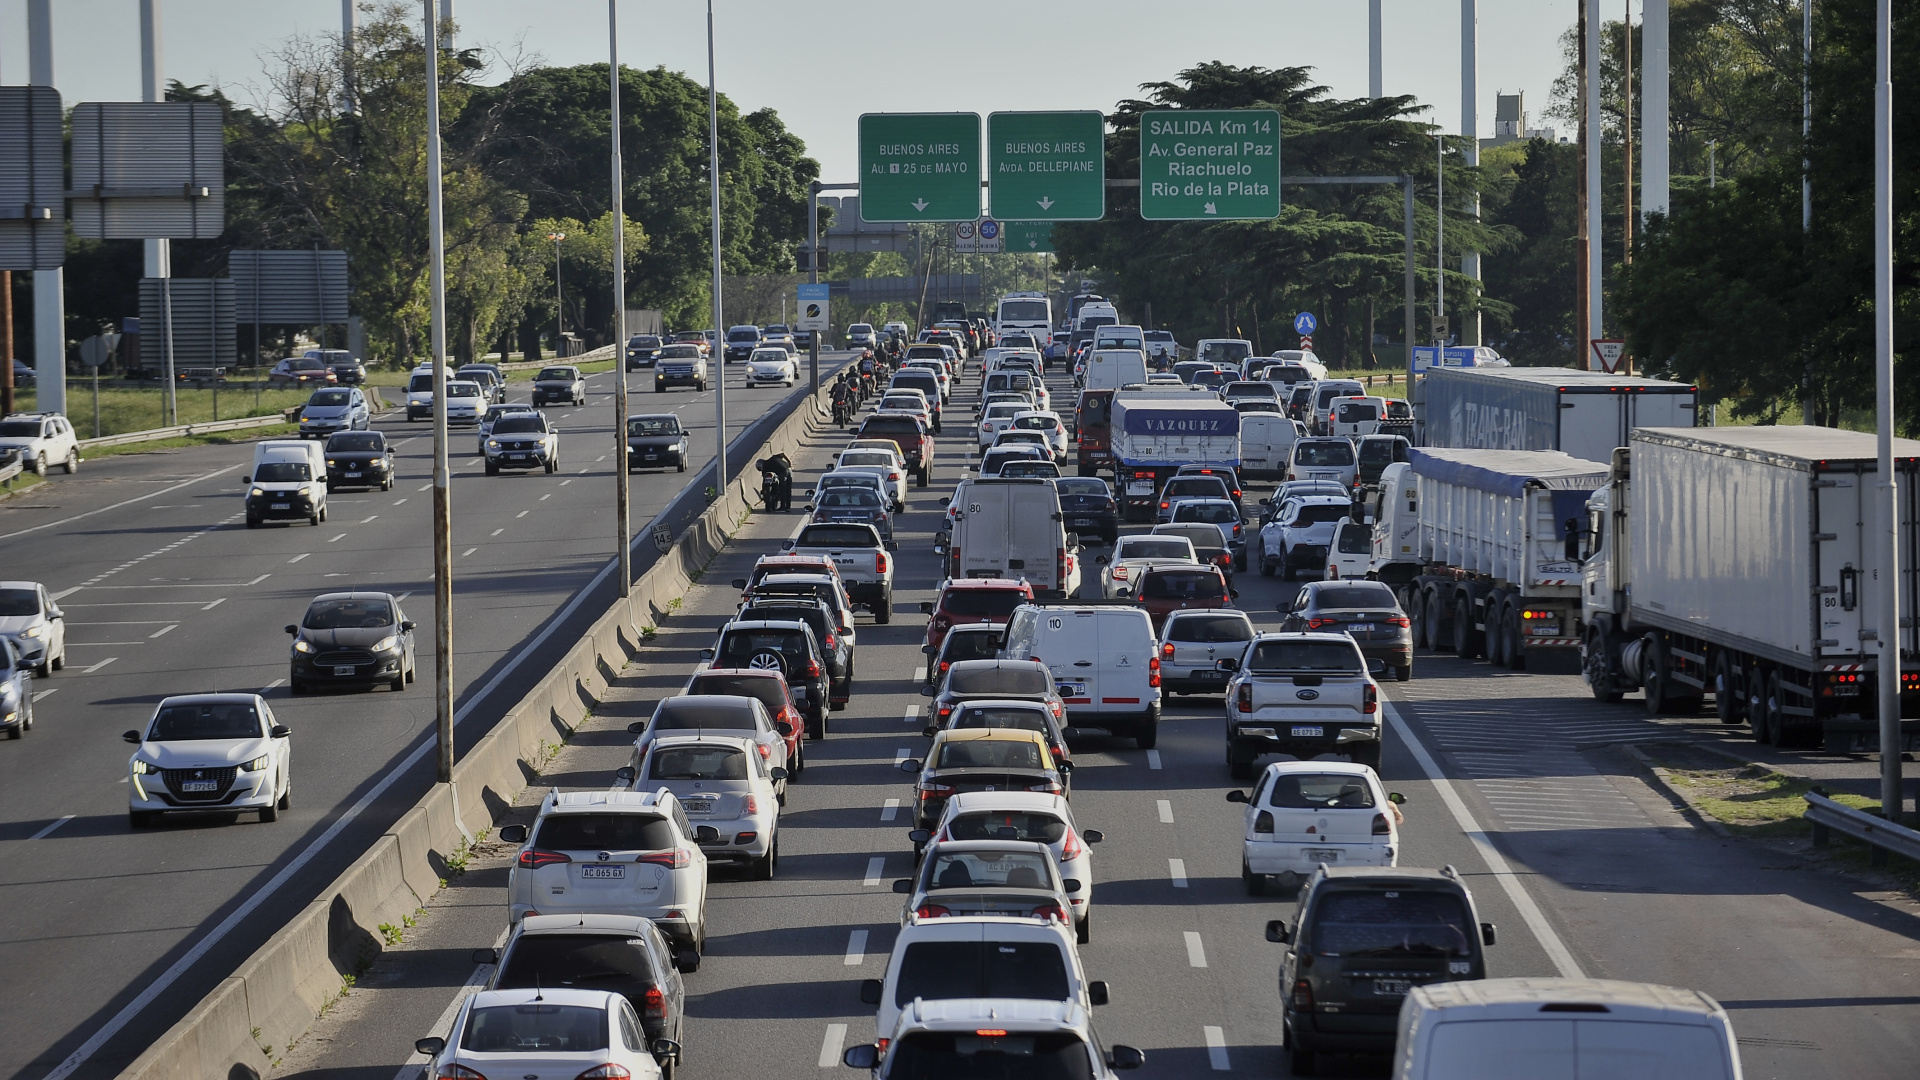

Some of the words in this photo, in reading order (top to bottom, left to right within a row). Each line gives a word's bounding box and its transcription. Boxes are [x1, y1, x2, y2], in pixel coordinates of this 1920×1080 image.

[1150, 120, 1214, 135] SALIDA
[1220, 120, 1246, 134] Km
[1252, 120, 1271, 134] 14
[879, 144, 924, 155] BUENOS
[927, 143, 959, 154] AIRES
[1006, 142, 1050, 153] BUENOS
[1054, 142, 1086, 153] AIRES
[1173, 142, 1238, 156] General
[1243, 142, 1273, 156] Paz
[903, 163, 917, 174] 25
[920, 165, 932, 173] DE
[935, 162, 968, 173] MAYO
[1028, 161, 1094, 172] DELLEPIANE
[1168, 161, 1252, 176] Riachuelo
[1151, 182, 1179, 196] Rio
[1184, 182, 1204, 196] de
[1208, 182, 1222, 196] la
[1227, 182, 1269, 196] Plata
[959, 226, 972, 234] 100
[982, 225, 996, 234] 50
[1145, 420, 1219, 431] VAZQUEZ
[1406, 490, 1416, 498] 80
[969, 504, 981, 513] 80
[1824, 597, 1837, 607] 80
[1049, 618, 1062, 629] 110
[583, 869, 594, 878] AC
[596, 869, 611, 878] 065
[612, 869, 623, 878] GX
